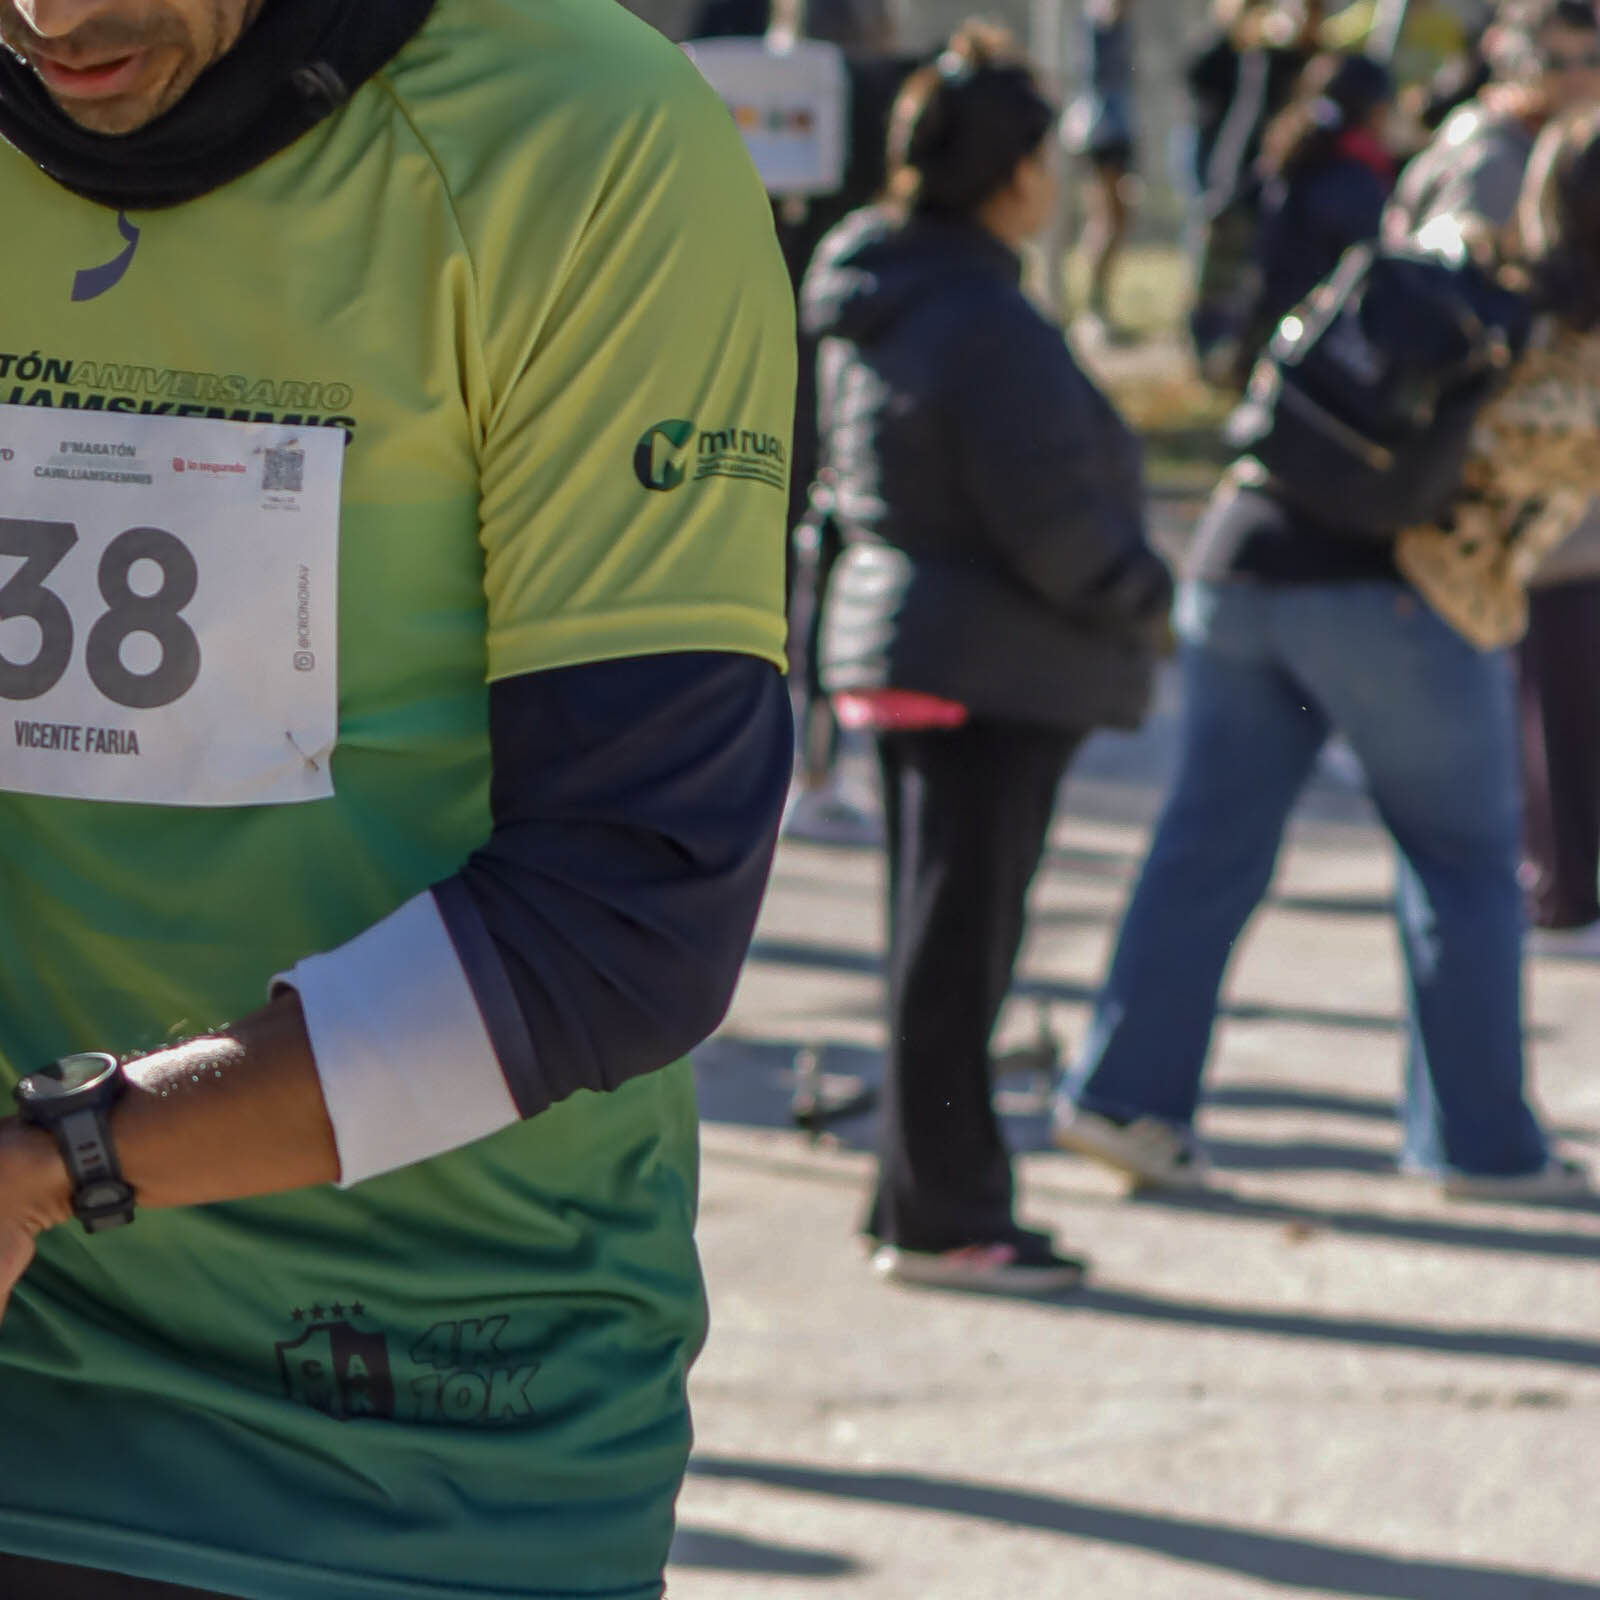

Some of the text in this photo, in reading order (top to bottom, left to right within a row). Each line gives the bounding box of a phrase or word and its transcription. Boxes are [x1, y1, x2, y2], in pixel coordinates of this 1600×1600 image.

[68, 359, 355, 412] ANIVERSARIO
[14, 720, 140, 756] VICENTE FARIA
[409, 1363, 541, 1422] 10K
